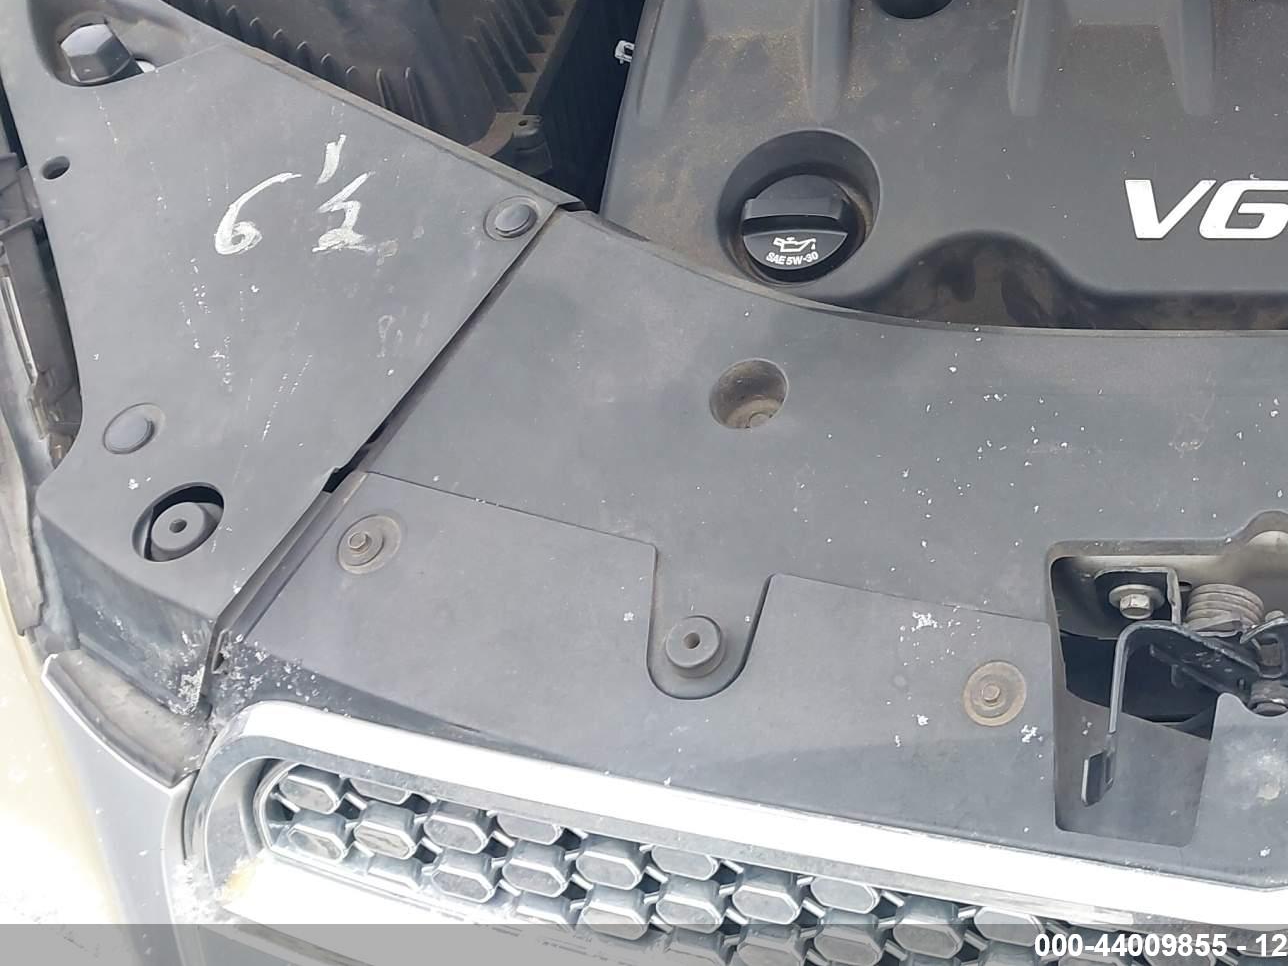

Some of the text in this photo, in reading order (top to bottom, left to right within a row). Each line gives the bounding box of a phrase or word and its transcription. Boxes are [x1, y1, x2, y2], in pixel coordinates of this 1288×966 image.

[214, 172, 302, 255] 6
[766, 251, 819, 265] SAE 5W-30
